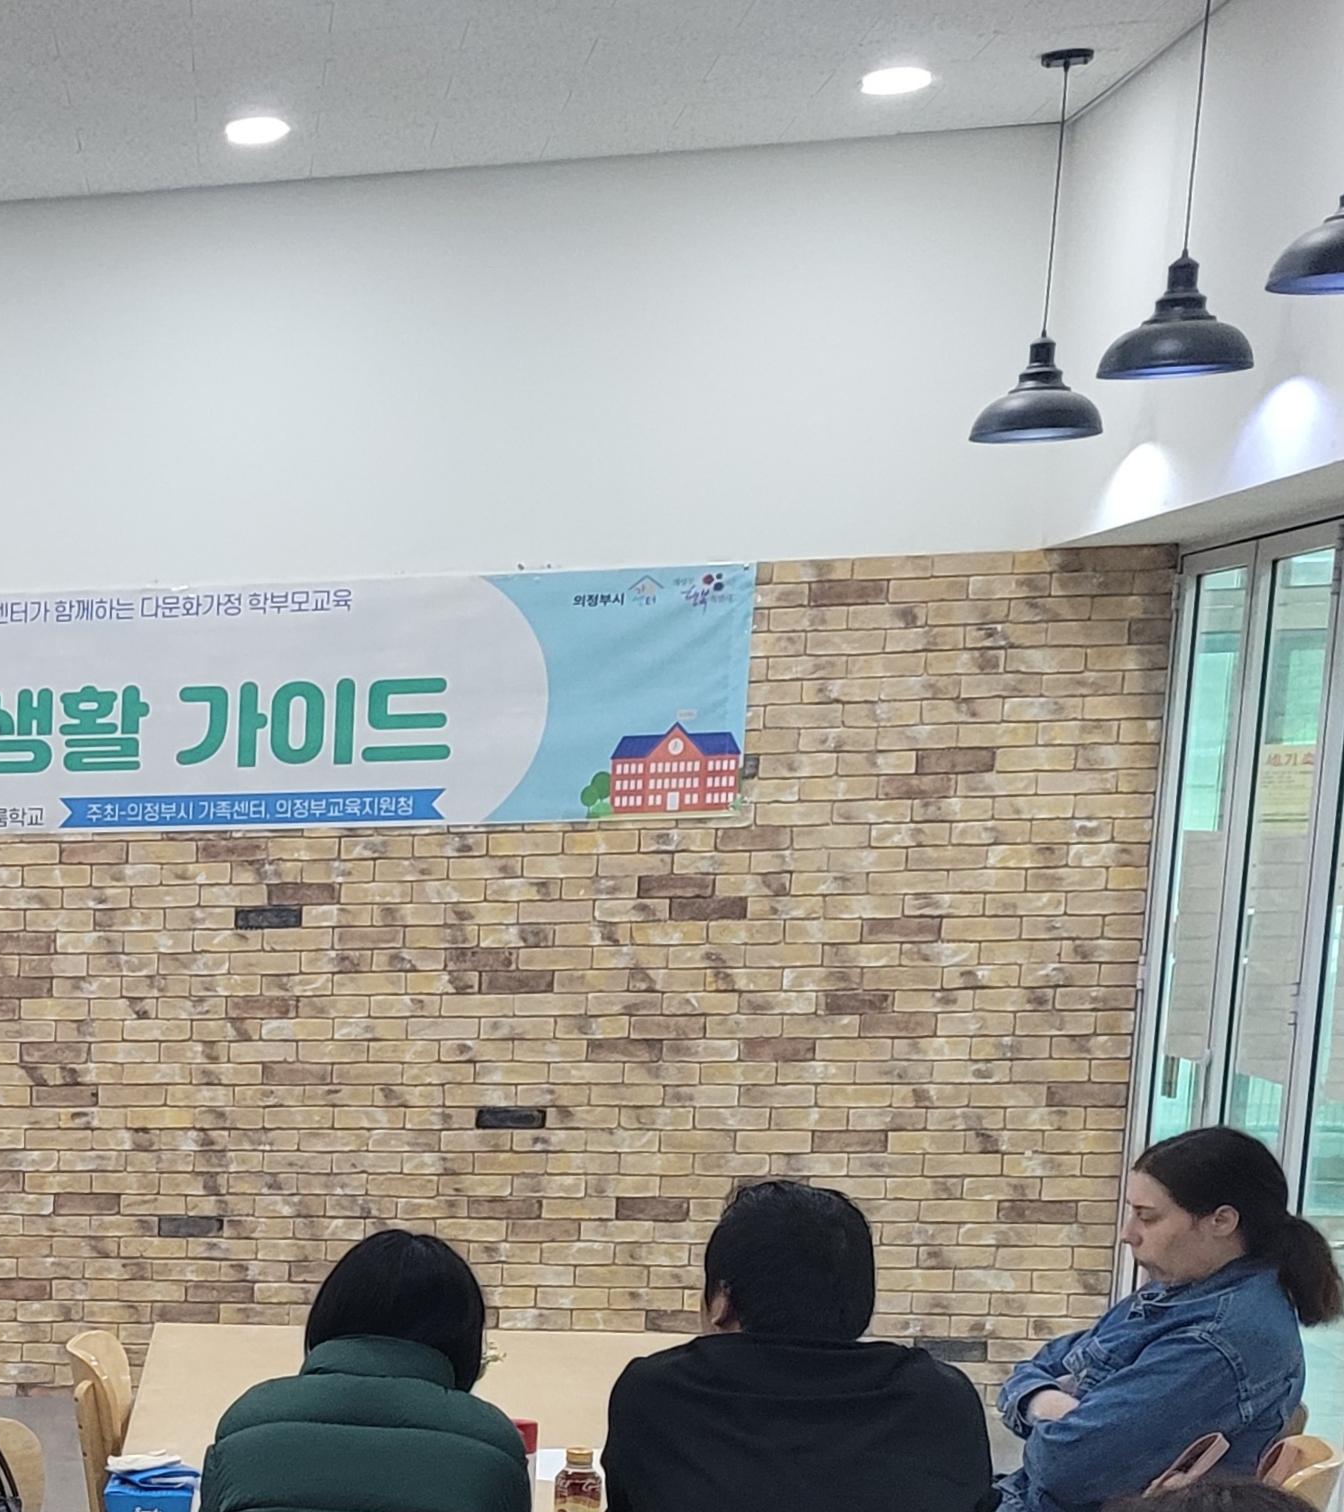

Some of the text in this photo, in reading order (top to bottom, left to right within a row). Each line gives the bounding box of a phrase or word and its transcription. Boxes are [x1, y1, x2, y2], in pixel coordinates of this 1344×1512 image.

[55, 597, 135, 623] 함께하는
[141, 593, 242, 619] 다문화가정
[248, 588, 353, 615] 학부모교육
[572, 592, 625, 608] 의정부시
[175, 677, 452, 768] 가이드
[86, 796, 414, 822] 주최-의정부시 가족센터, 의정부교육지원청
